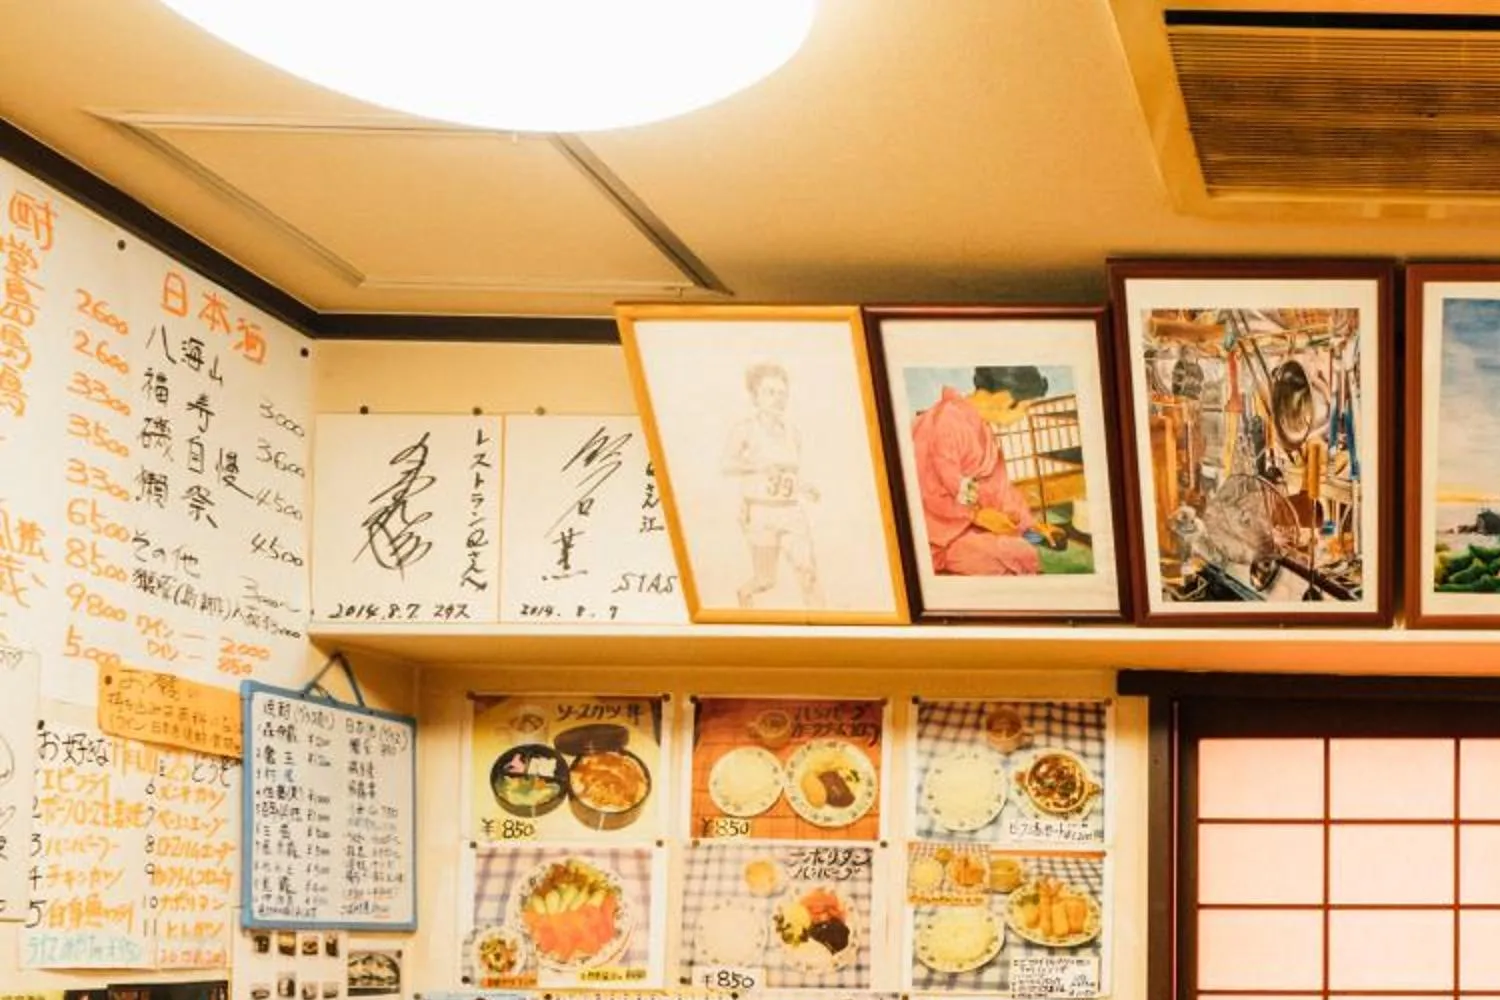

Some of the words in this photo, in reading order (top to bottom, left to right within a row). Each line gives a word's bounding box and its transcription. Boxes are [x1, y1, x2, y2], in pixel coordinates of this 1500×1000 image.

[159, 271, 267, 365] 日本酒
[145, 325, 224, 387] 八海山
[132, 529, 201, 579] その他
[251, 532, 304, 567] 4500
